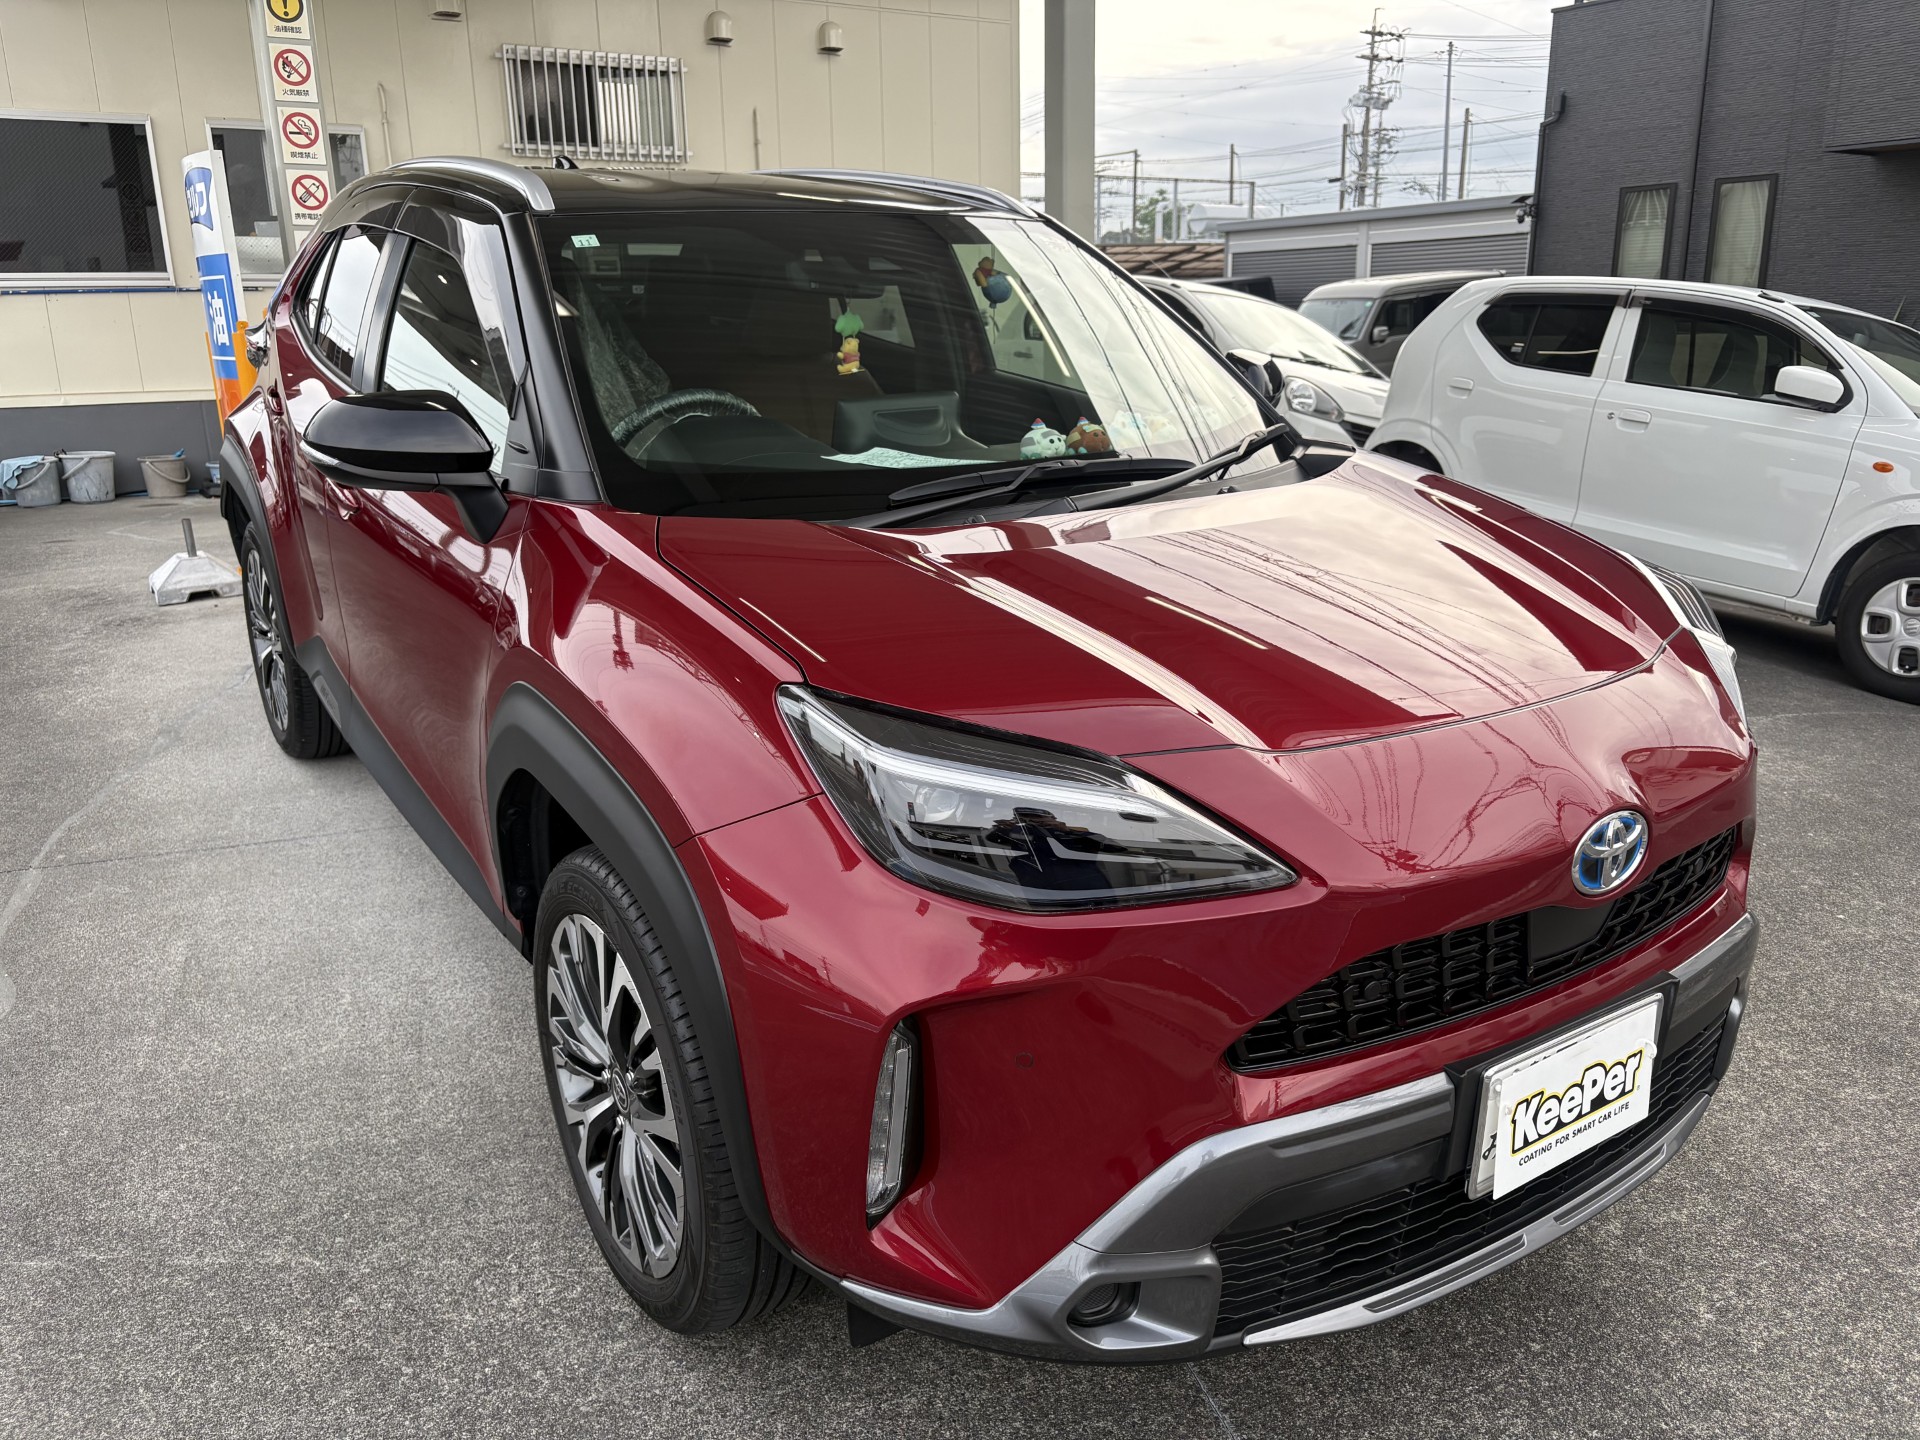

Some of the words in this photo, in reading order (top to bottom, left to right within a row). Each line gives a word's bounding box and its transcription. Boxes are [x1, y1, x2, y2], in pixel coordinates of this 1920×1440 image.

[282, 88, 309, 97] 火気厳禁
[290, 151, 318, 160] 喫煙禁止
[1512, 1050, 1643, 1154] KeePer
[1519, 1143, 1552, 1166] COATING
[1555, 1133, 1570, 1147] FOR
[1572, 1119, 1596, 1138] SMART
[1597, 1111, 1612, 1124] CAR
[1613, 1101, 1630, 1116] LIFE
